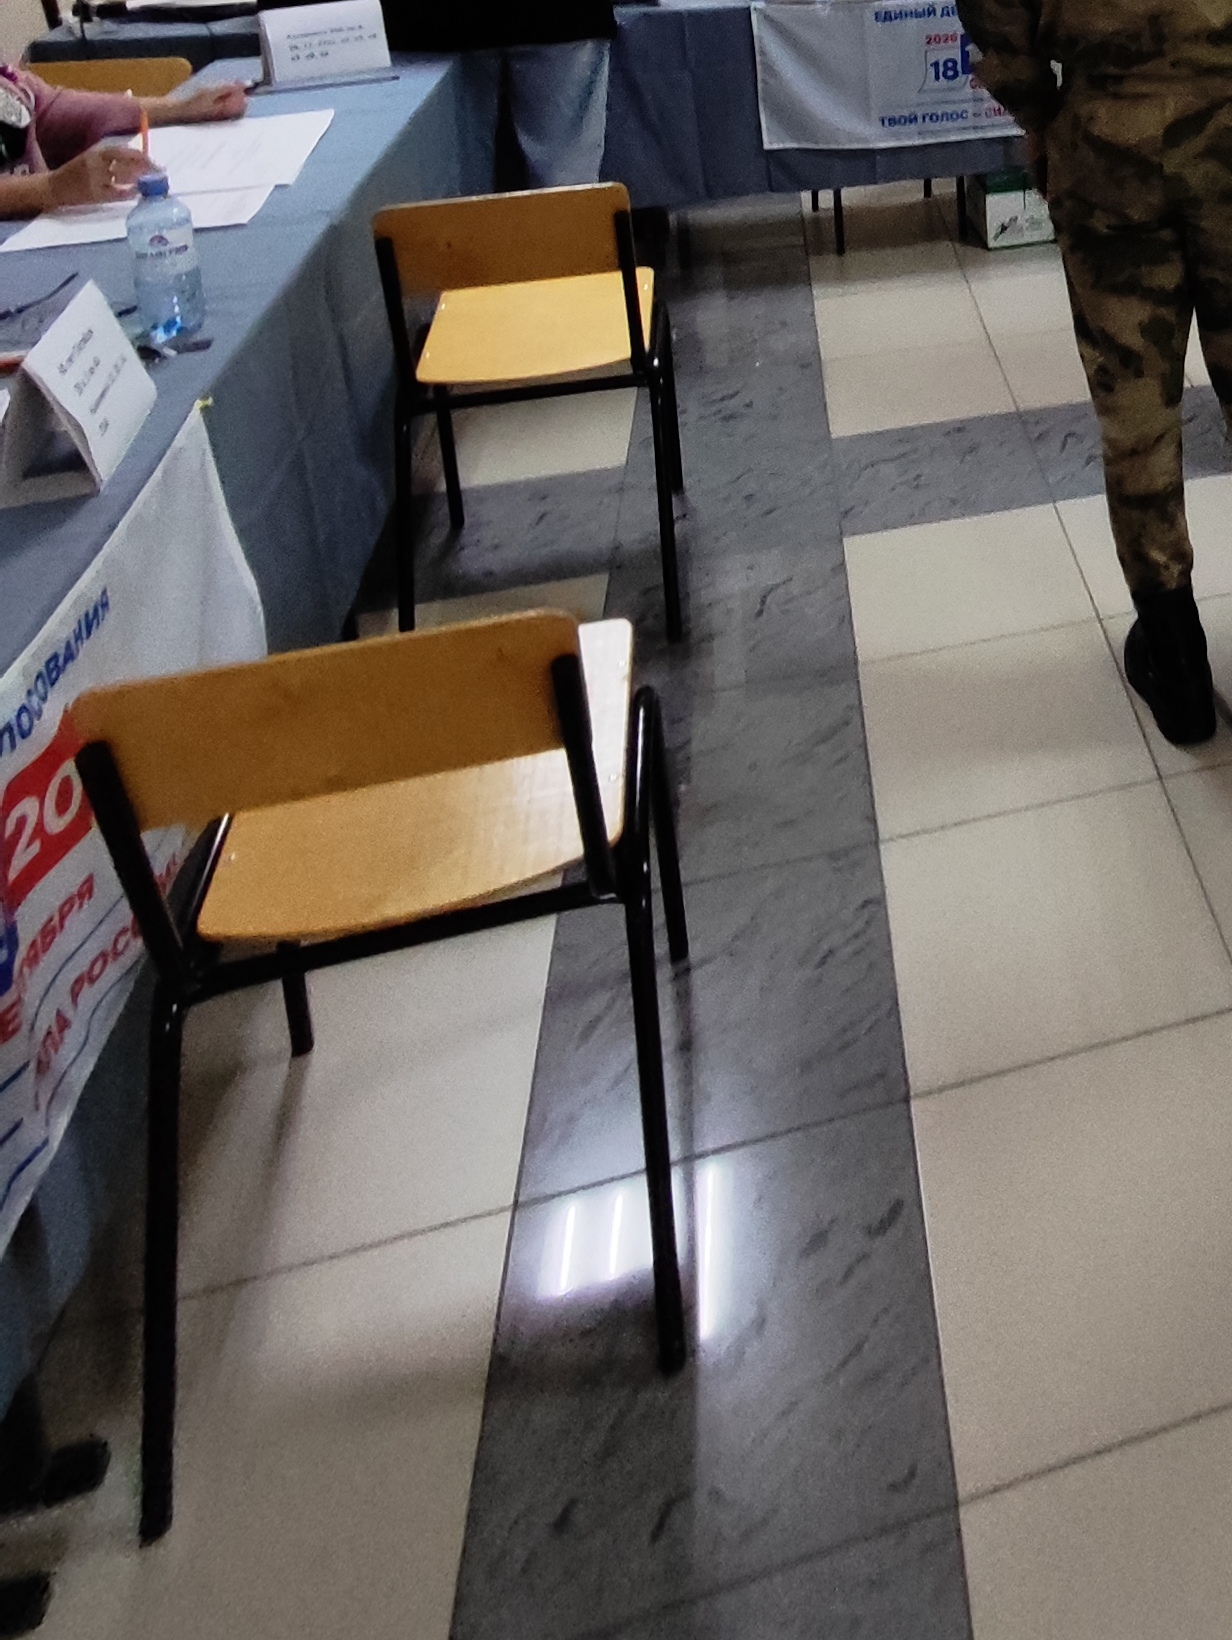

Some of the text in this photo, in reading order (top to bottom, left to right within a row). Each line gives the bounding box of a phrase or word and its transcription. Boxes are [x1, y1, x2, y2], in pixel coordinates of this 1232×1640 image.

[874, 3, 937, 23] ЕДИНЫЙ
[929, 58, 960, 82] 18
[880, 112, 919, 127] ТВОЙ
[922, 109, 969, 123] ГОЛОС
[4, 758, 84, 886] 20
